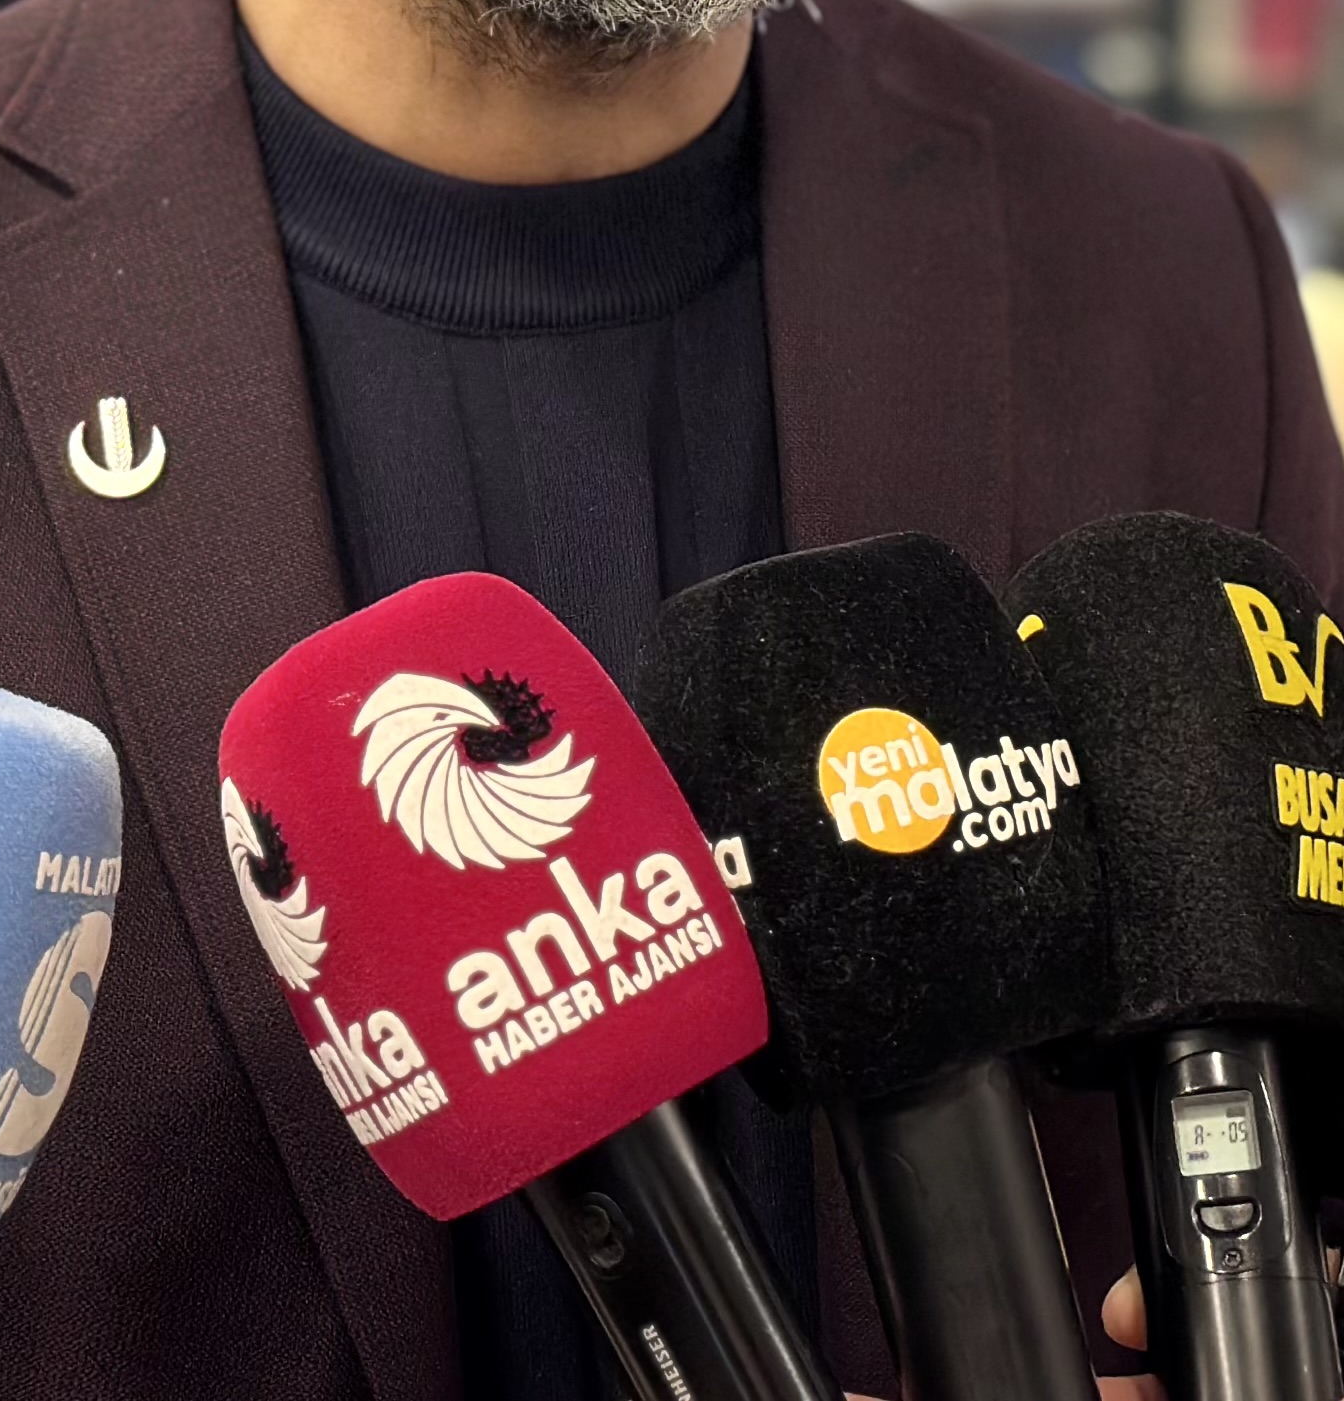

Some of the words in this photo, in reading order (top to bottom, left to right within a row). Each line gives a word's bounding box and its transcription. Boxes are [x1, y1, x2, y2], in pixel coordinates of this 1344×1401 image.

[828, 723, 929, 796] yeni
[830, 736, 1080, 841] malatya
[953, 796, 1052, 852] .com
[447, 852, 704, 1029] anka
[473, 978, 605, 1074] HABER
[609, 912, 723, 1004] AJANSI
